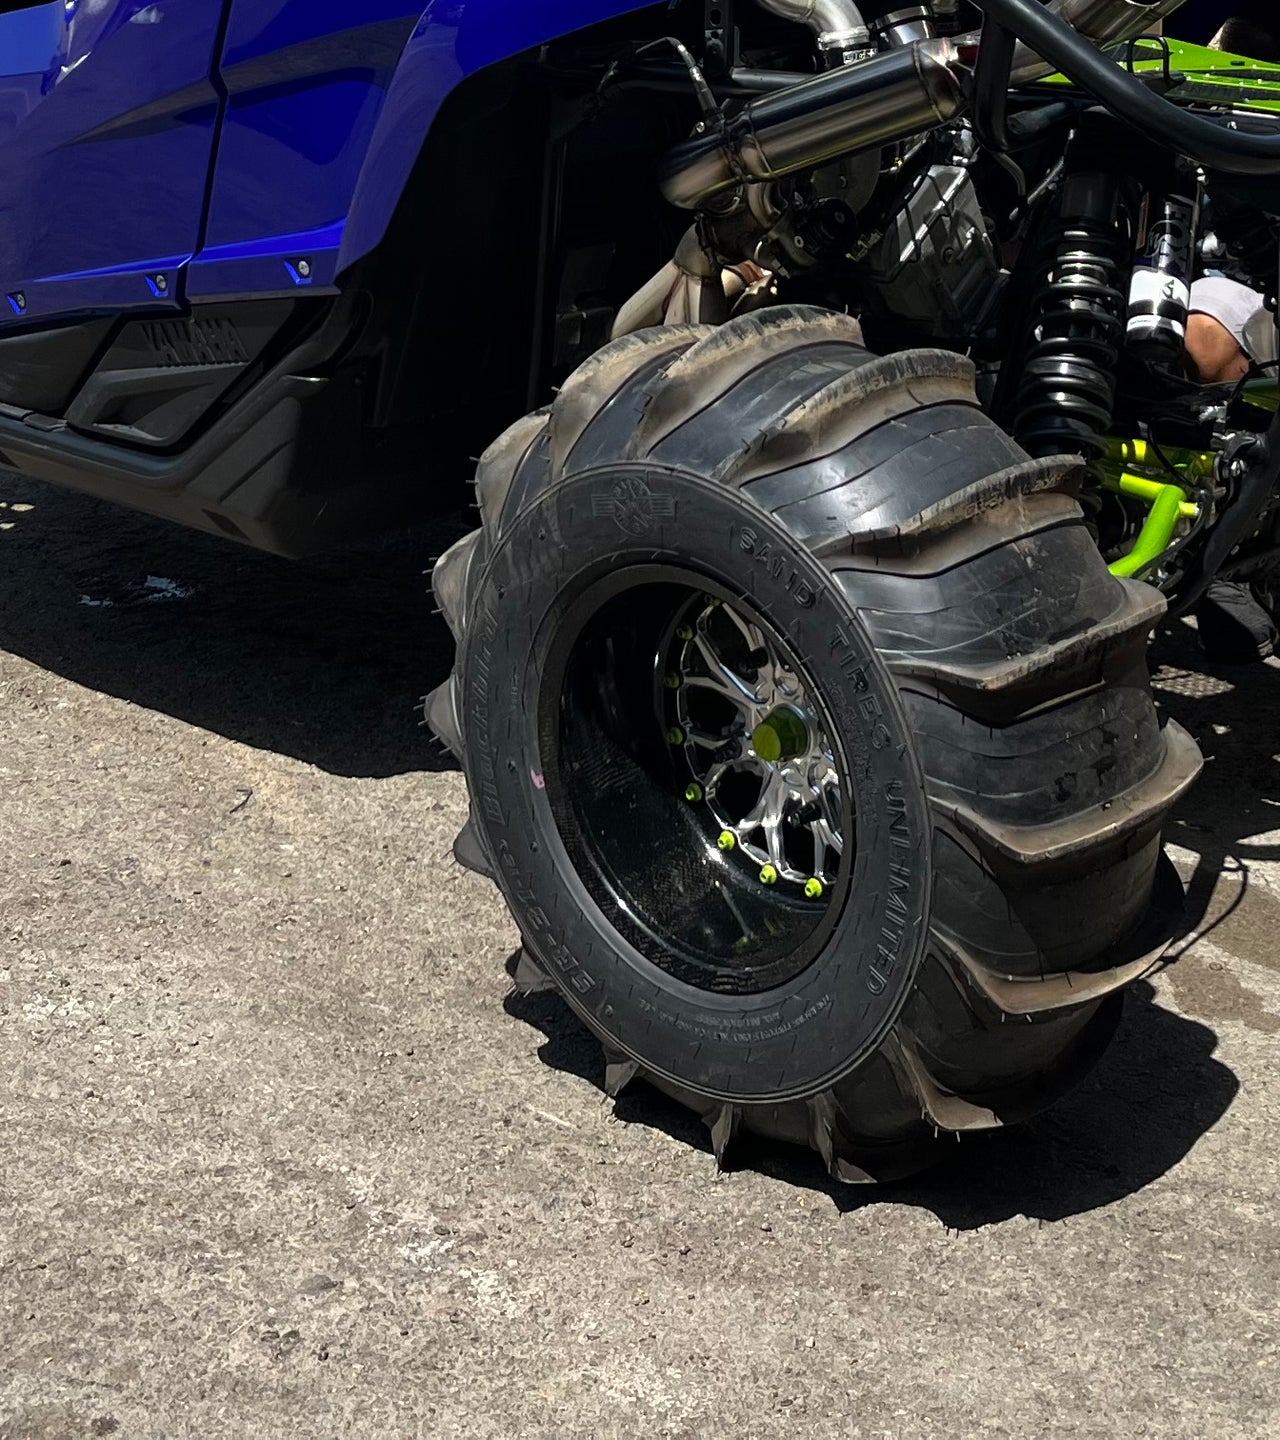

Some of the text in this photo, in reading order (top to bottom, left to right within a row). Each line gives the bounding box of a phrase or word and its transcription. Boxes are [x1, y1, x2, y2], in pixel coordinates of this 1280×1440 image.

[138, 317, 252, 365] YAMAHA
[470, 606, 506, 828] Blackbird
[737, 526, 819, 610] SAND
[826, 624, 893, 752] TIRES
[868, 780, 911, 997] UNLIMITED
